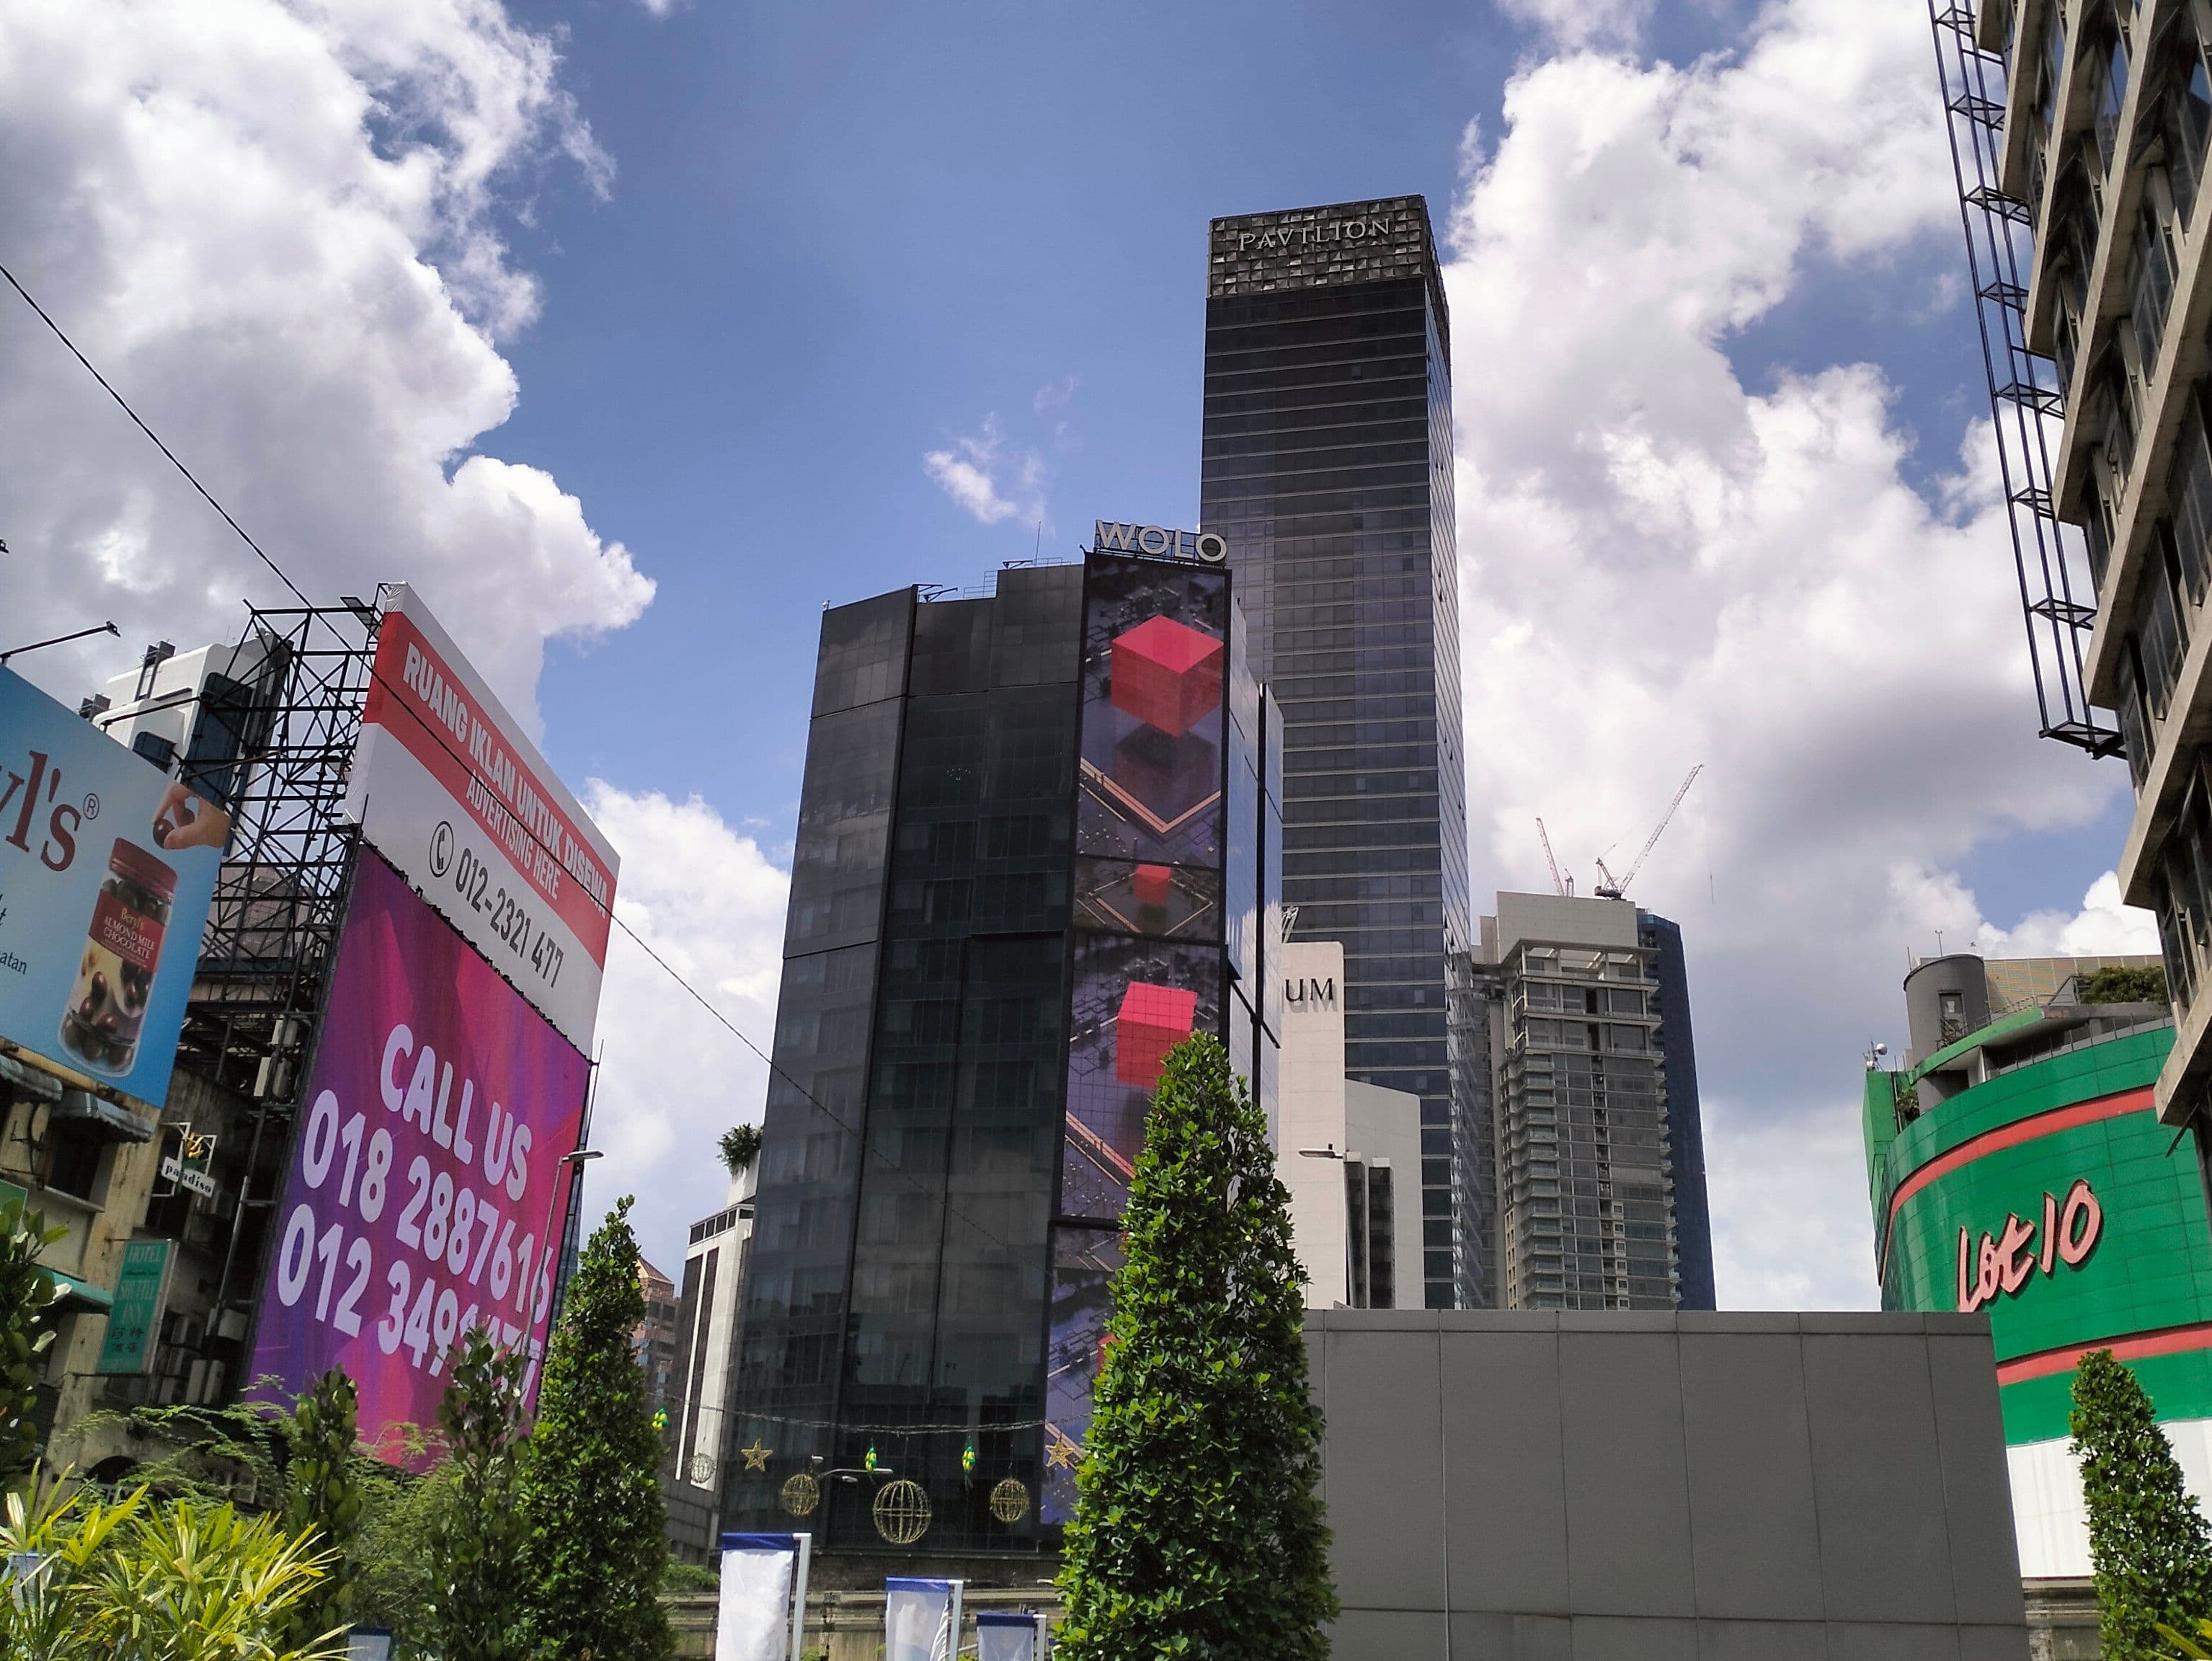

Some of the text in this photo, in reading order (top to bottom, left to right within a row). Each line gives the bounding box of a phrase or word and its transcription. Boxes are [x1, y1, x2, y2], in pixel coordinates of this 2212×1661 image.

[1238, 218, 1390, 252] PAVILION
[1096, 519, 1227, 562] WOLO
[403, 641, 608, 920] RUANG IKLAN UNTUK DISEWA
[466, 768, 561, 900] ADVERTISING HERE
[103, 915, 138, 941] ALMOND
[103, 926, 151, 960] CHOCOLATE
[456, 848, 565, 989] 012-2321 477
[1285, 978, 1333, 1001] UM
[380, 1024, 532, 1202] CALL US
[128, 1245, 162, 1262] HOTEL
[277, 1203, 373, 1339] 012
[302, 1089, 554, 1324] 018 2887616
[1957, 1179, 2102, 1313] Lot 10
